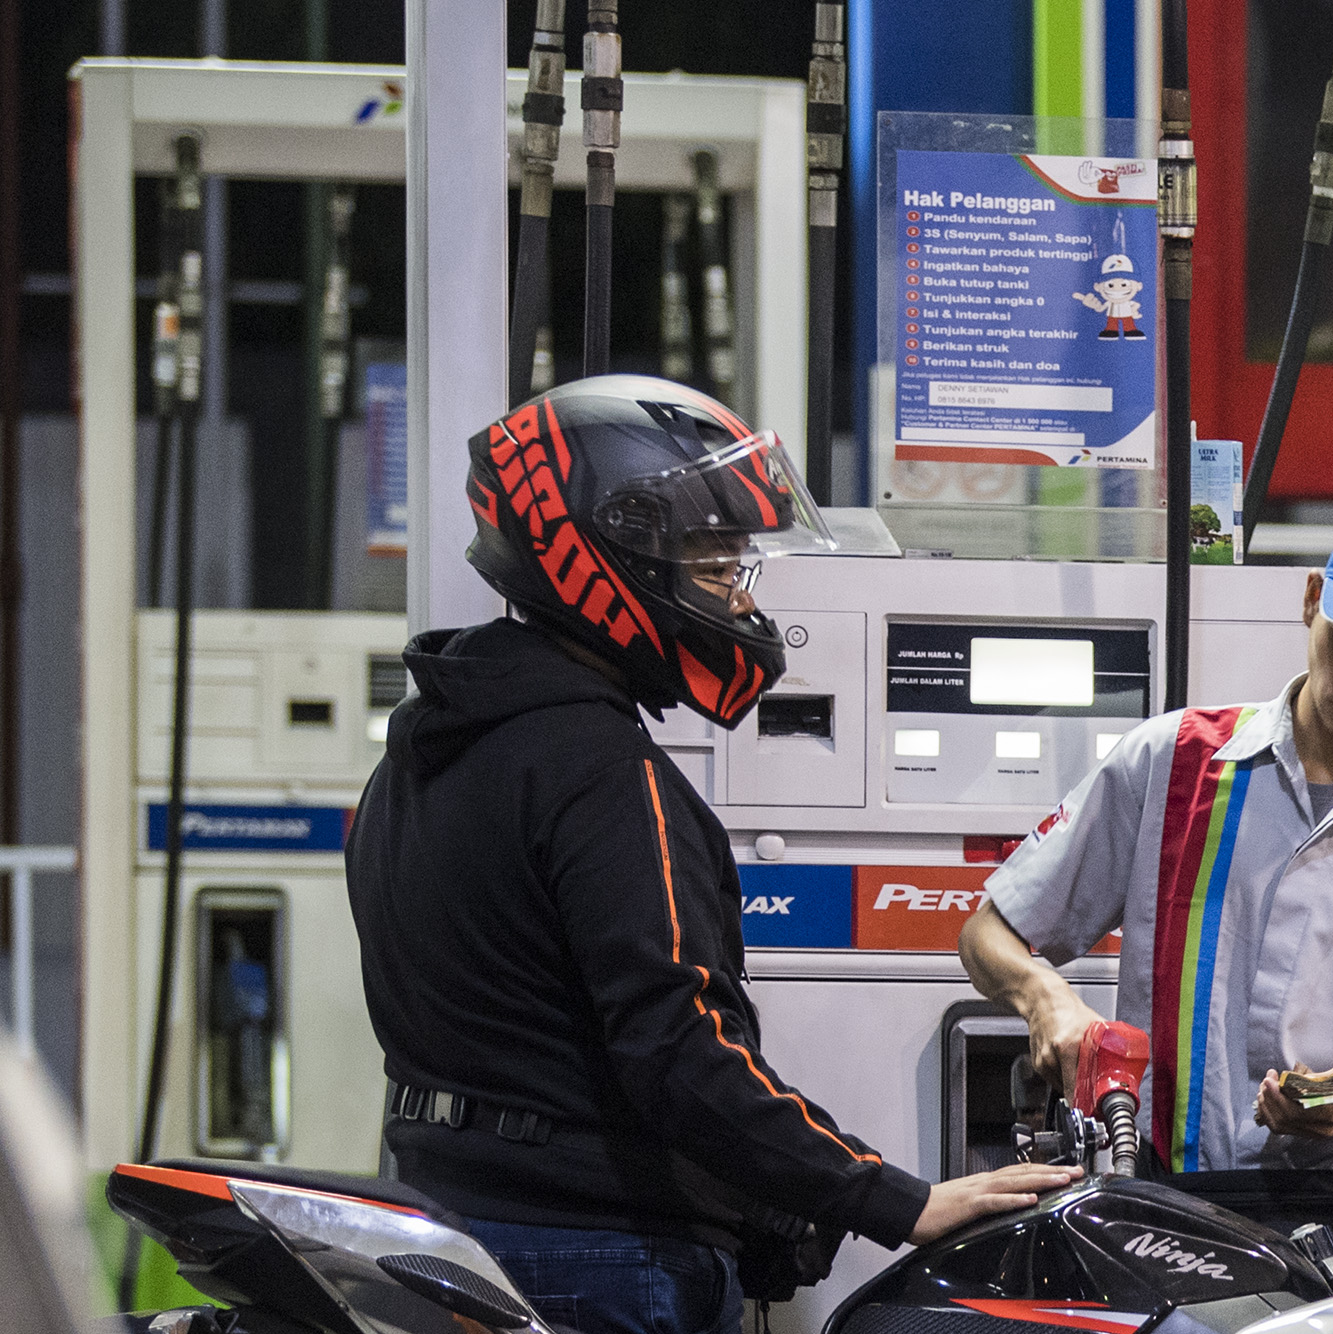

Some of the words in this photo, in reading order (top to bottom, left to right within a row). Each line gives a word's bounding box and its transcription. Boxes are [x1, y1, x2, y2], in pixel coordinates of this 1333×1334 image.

[904, 190, 944, 207] Hak
[950, 192, 1056, 213] Pelanggan
[924, 213, 965, 223] Pandu
[969, 214, 1037, 225] kendaraan
[924, 229, 940, 238] 3S
[944, 229, 1004, 242] (Senyum,
[1008, 232, 1051, 243] Salam,
[1055, 233, 1092, 245] Sapa)
[924, 244, 987, 255] Tawarkan
[990, 246, 1035, 258] produk
[1038, 248, 1093, 261] tertinggi
[924, 261, 979, 273] Ingatkan
[983, 263, 1029, 274] bahaya
[924, 277, 957, 287] Buka
[960, 278, 994, 290] tutup
[997, 279, 1029, 289] tanki
[923, 292, 991, 305] Tunjukkan
[994, 295, 1033, 307] angka
[1037, 297, 1044, 306] 0
[923, 309, 938, 319] Isi
[942, 309, 952, 319] &
[955, 310, 1011, 321] interaksi
[923, 325, 984, 336] Tunjukan
[986, 327, 1026, 339] angka
[1029, 328, 1078, 339] terakhir
[923, 341, 972, 351] Berikan
[976, 343, 1009, 353] struk
[923, 357, 967, 367] Terima
[971, 358, 1005, 368] kasih
[1009, 359, 1033, 370] dan
[1036, 360, 1060, 371] doa
[938, 384, 966, 392] DENNY
[968, 385, 1009, 393] SETIAWAN
[898, 650, 926, 658] JUMLAH
[954, 652, 964, 660] Rp
[873, 883, 992, 912] PERT
[1124, 1232, 1234, 1280] Ninja
